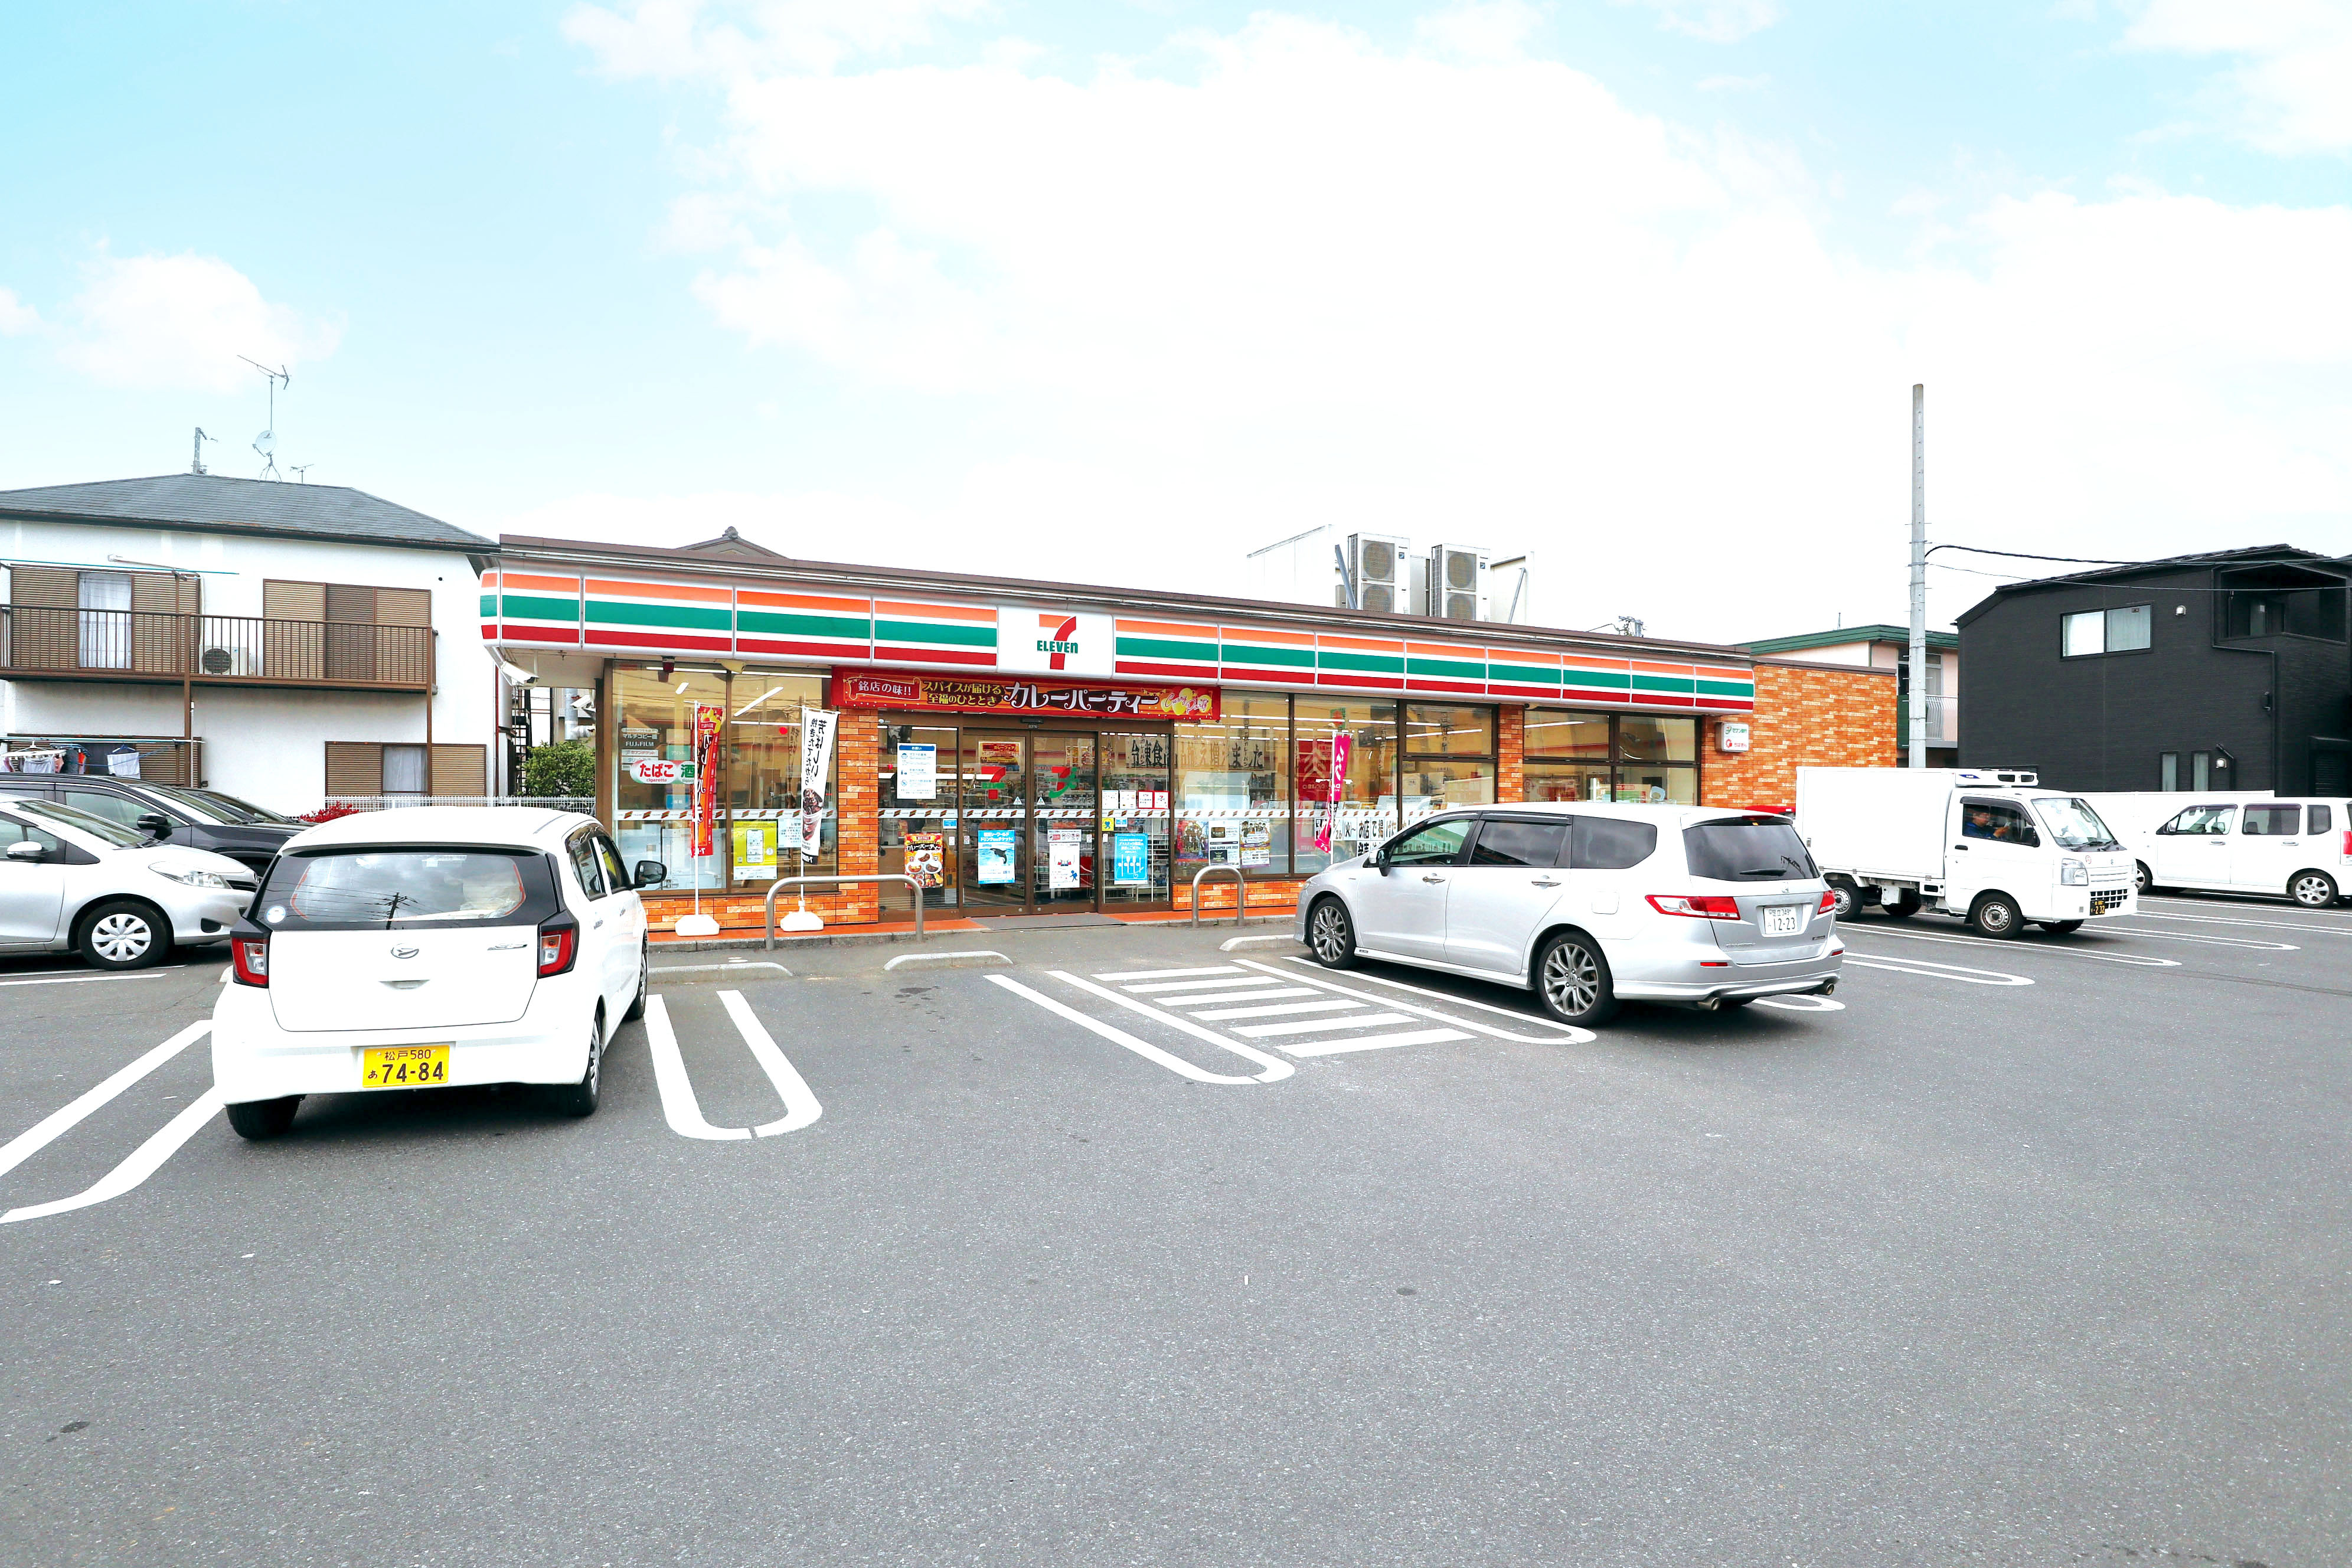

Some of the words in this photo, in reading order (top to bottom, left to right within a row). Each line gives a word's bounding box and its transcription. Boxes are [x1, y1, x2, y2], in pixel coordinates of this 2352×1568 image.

[858, 681, 912, 695] 銘店の味!!
[922, 681, 1002, 695] スパイスが届ける
[927, 693, 997, 705] 至福のひととき
[1004, 682, 1159, 713] カレーパーティー
[1165, 694, 1187, 708] Curry
[1185, 699, 1209, 713] Party
[639, 763, 674, 778] たばこ
[681, 765, 695, 778] 酒
[368, 1070, 377, 1079] あ
[383, 1061, 443, 1083] 74-84
